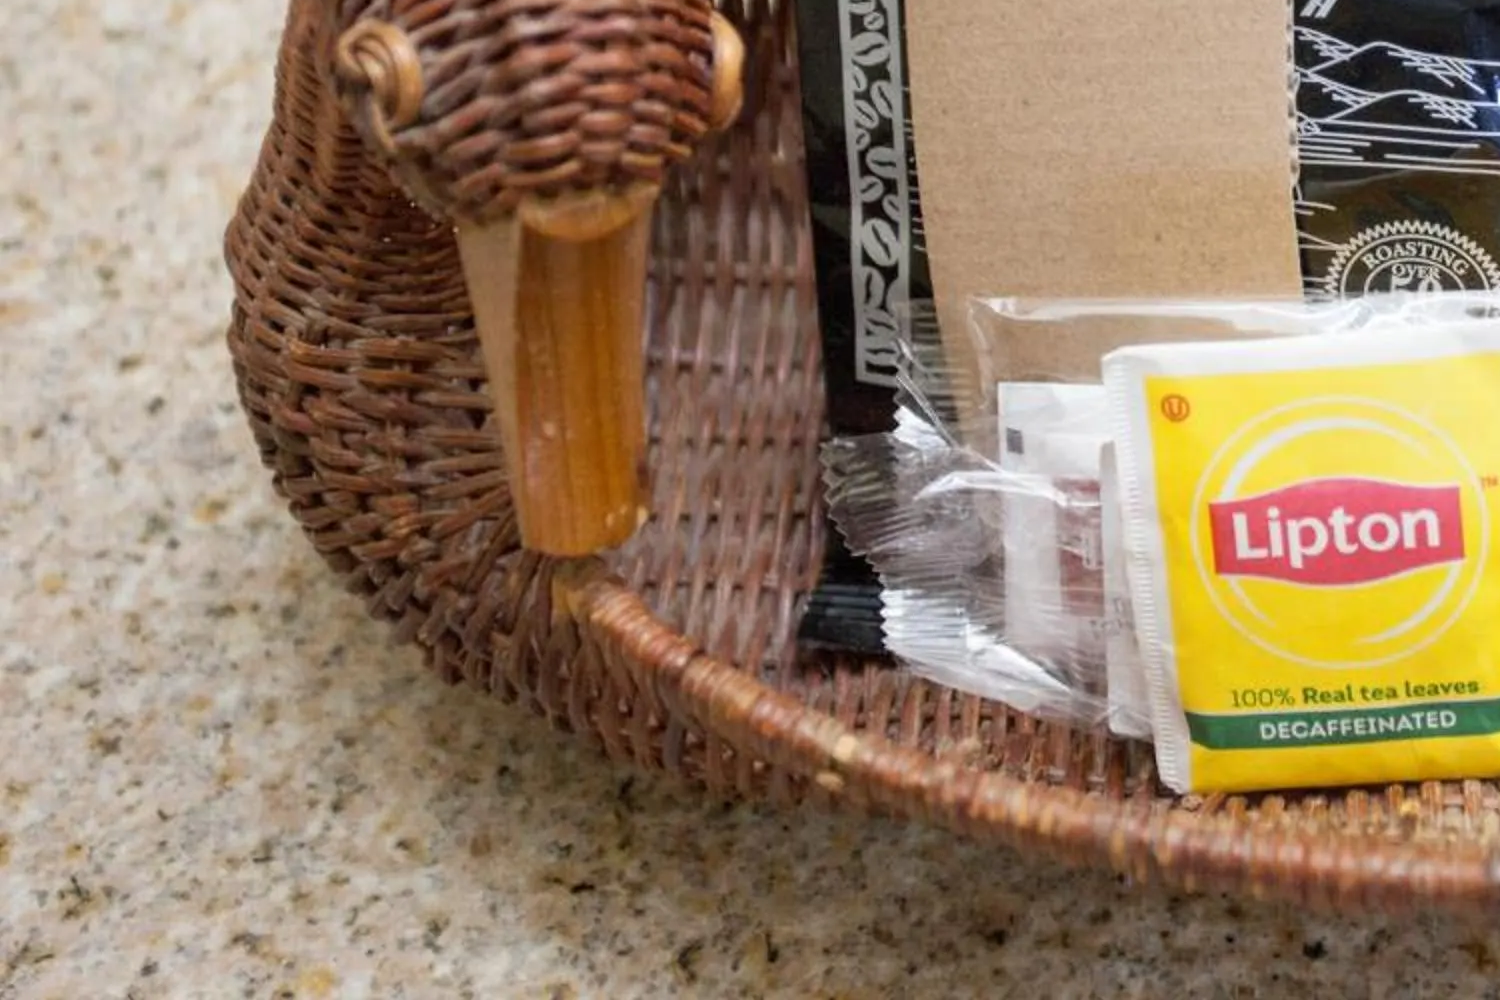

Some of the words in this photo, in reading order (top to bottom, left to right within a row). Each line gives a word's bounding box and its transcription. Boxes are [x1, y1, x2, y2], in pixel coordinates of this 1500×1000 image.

[1361, 241, 1470, 276] ROASTING
[1391, 263, 1441, 280] OVER
[1232, 506, 1440, 569] Lipton
[1232, 687, 1295, 708] 100%
[1303, 684, 1356, 704] Real
[1361, 684, 1398, 702] tea
[1405, 678, 1480, 699] leaves
[1259, 710, 1457, 741] DECAFFEINATED
